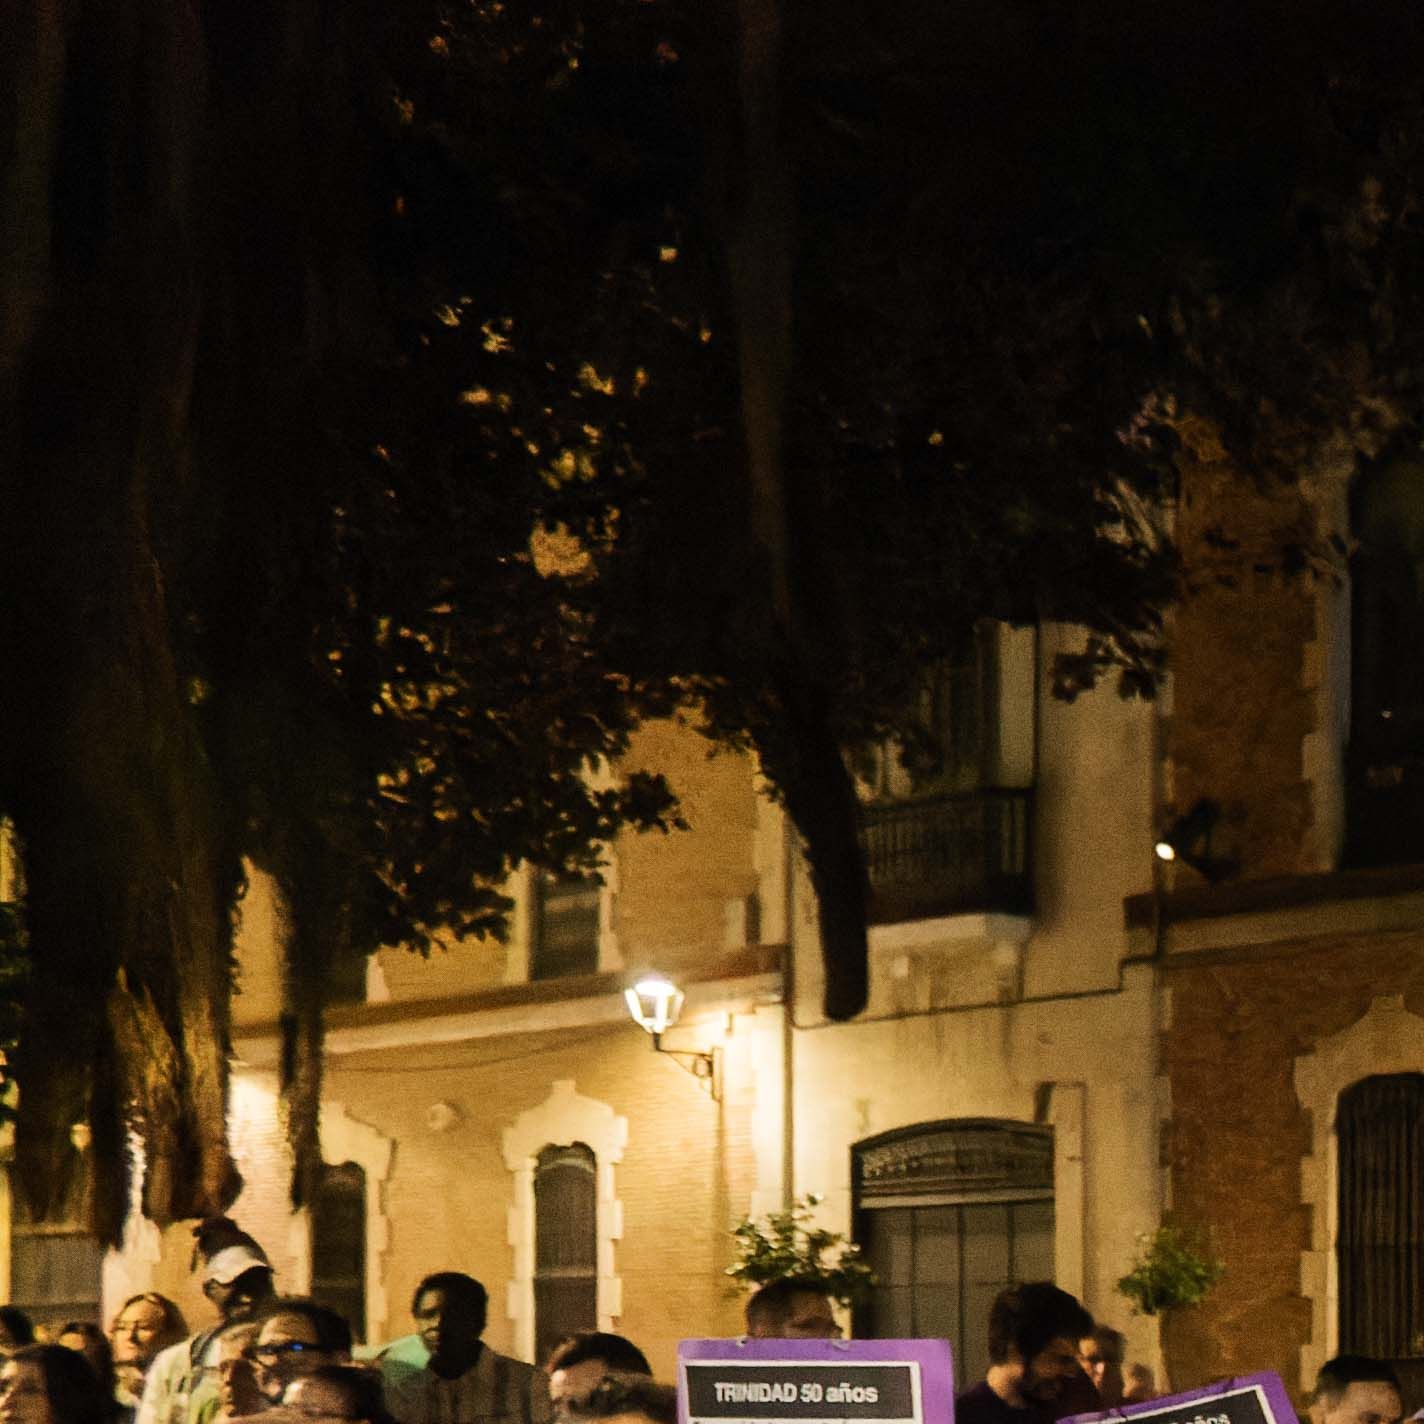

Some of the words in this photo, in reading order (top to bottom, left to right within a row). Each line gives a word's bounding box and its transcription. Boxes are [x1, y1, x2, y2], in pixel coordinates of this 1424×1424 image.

[714, 1382, 797, 1403] TRINIDAD
[800, 1382, 822, 1403] 50
[826, 1382, 878, 1403] años
